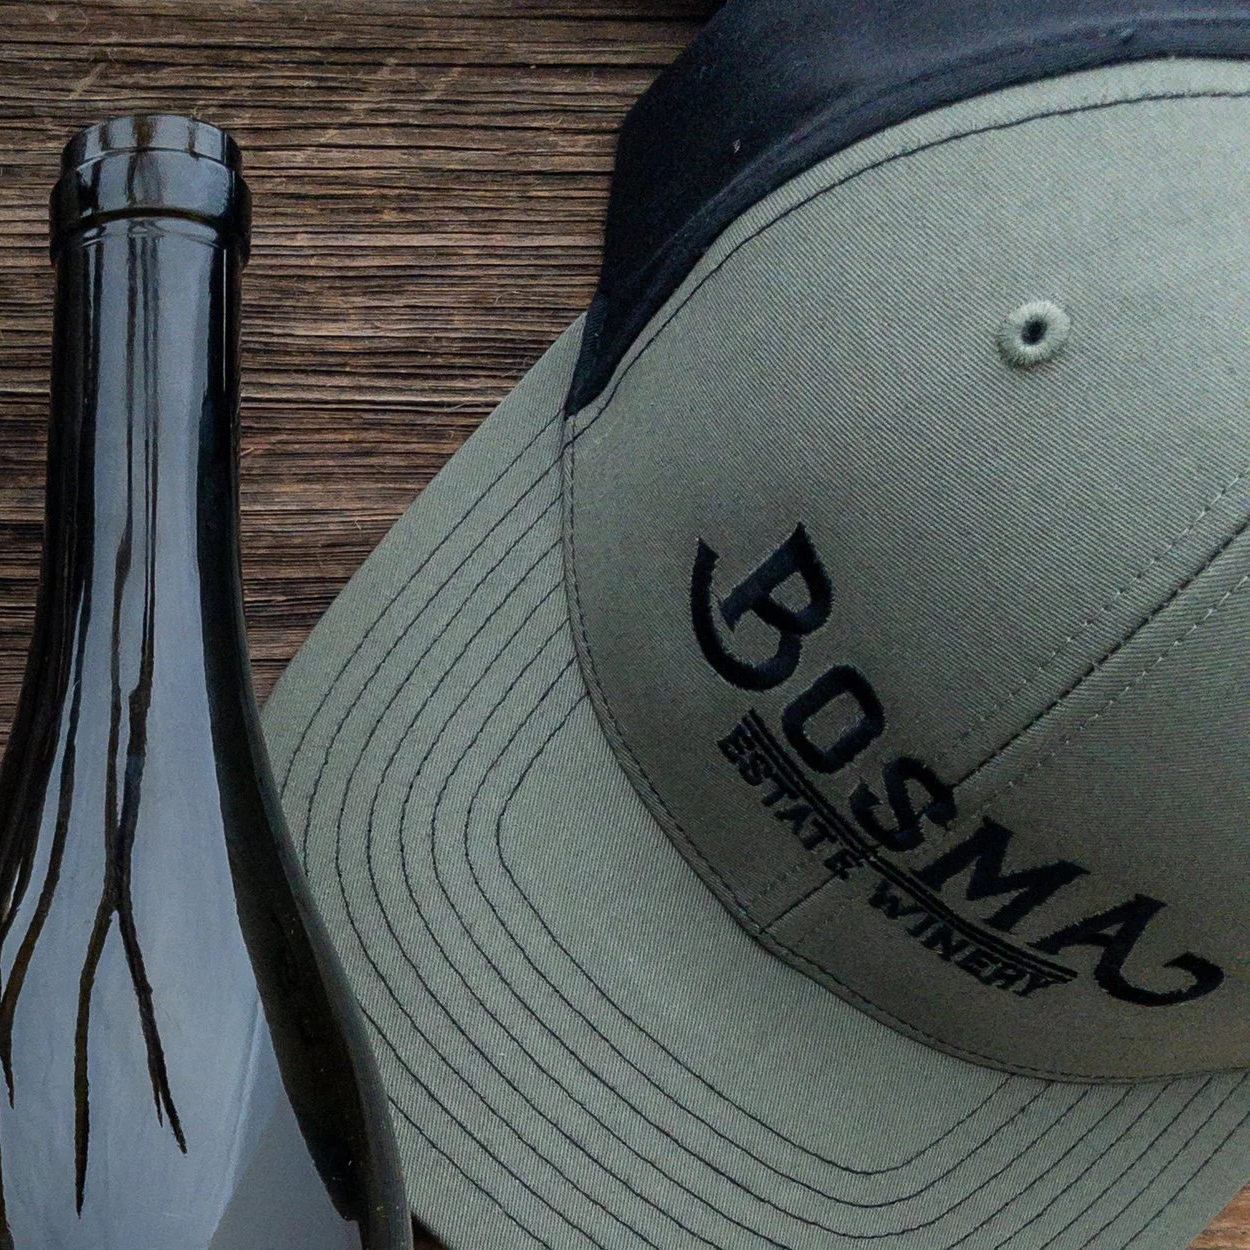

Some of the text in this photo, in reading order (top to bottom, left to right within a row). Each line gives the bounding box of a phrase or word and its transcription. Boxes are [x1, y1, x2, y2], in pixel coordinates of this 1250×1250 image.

[690, 522, 1224, 1007] BOSMA
[716, 723, 1062, 998] ESTATE WINERY
